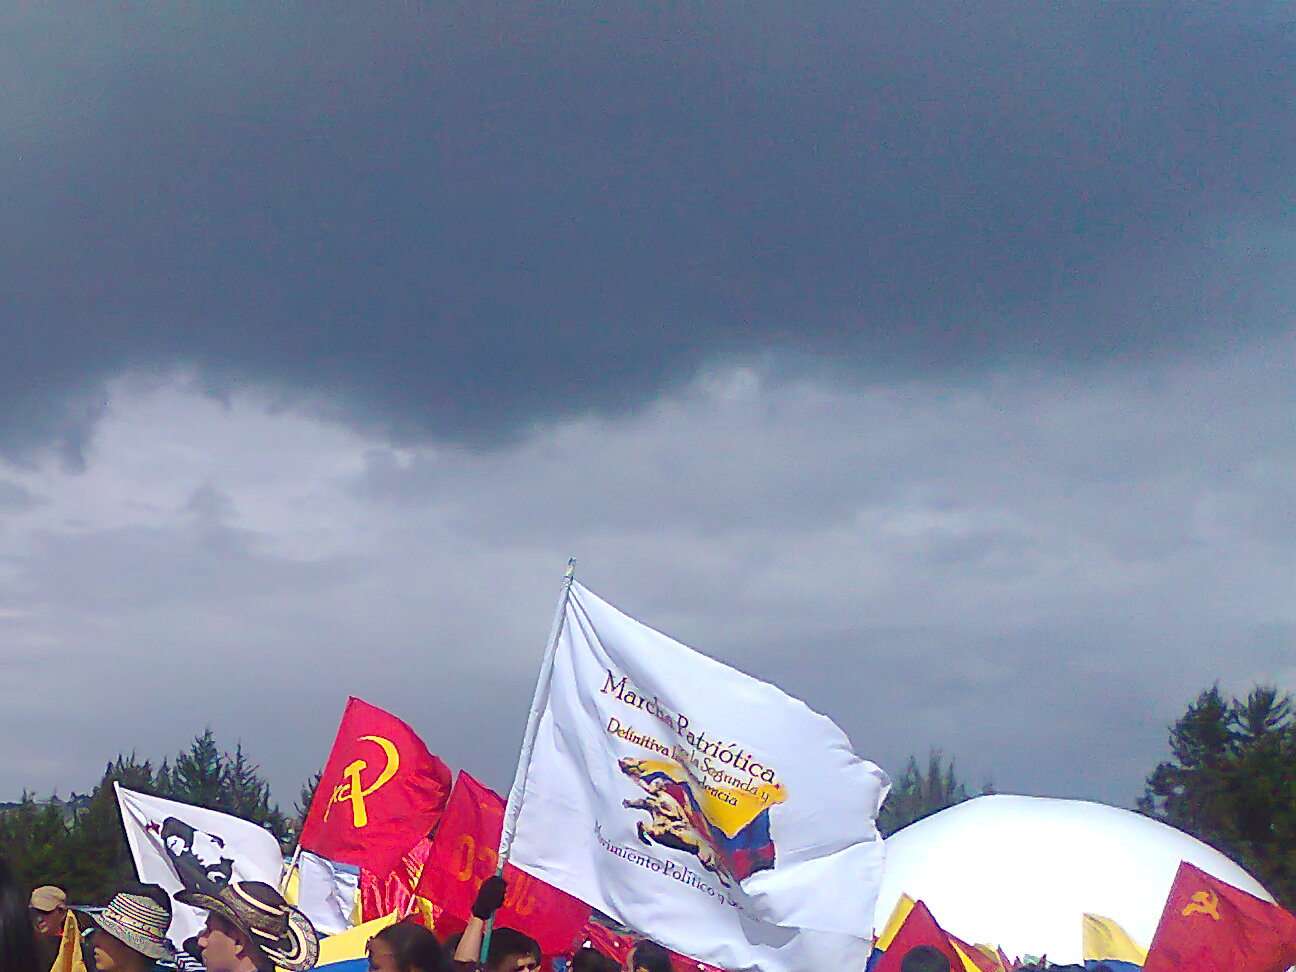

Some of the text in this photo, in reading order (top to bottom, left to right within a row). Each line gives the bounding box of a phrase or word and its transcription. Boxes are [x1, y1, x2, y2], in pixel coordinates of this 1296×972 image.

[600, 669, 776, 784] Marcha Patriótica
[701, 757, 758, 794] Segunda
[662, 860, 715, 896] Político
